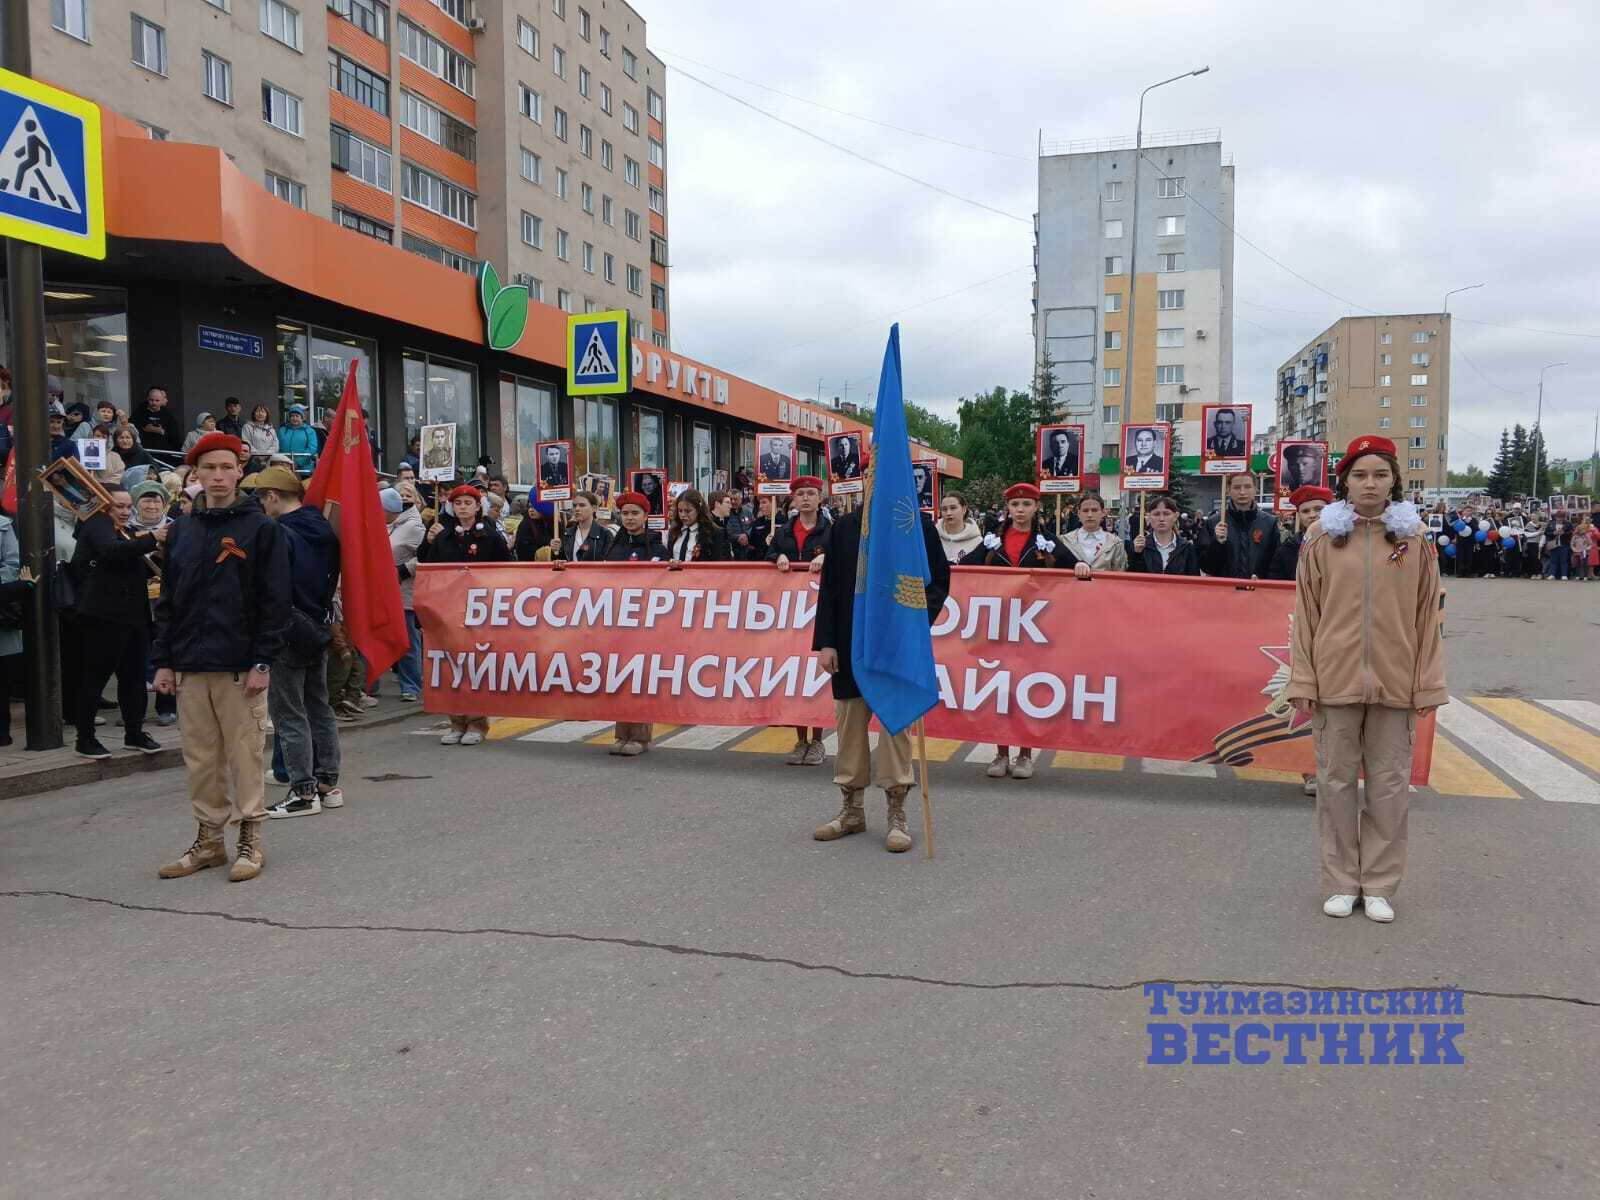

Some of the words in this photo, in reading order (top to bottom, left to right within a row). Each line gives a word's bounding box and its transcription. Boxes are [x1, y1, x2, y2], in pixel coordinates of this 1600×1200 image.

[254, 341, 260, 353] 5
[464, 581, 819, 631] БЕССМЕРТНЫЙ
[930, 596, 1050, 644] ОЛК
[934, 658, 1117, 723] АЙОН
